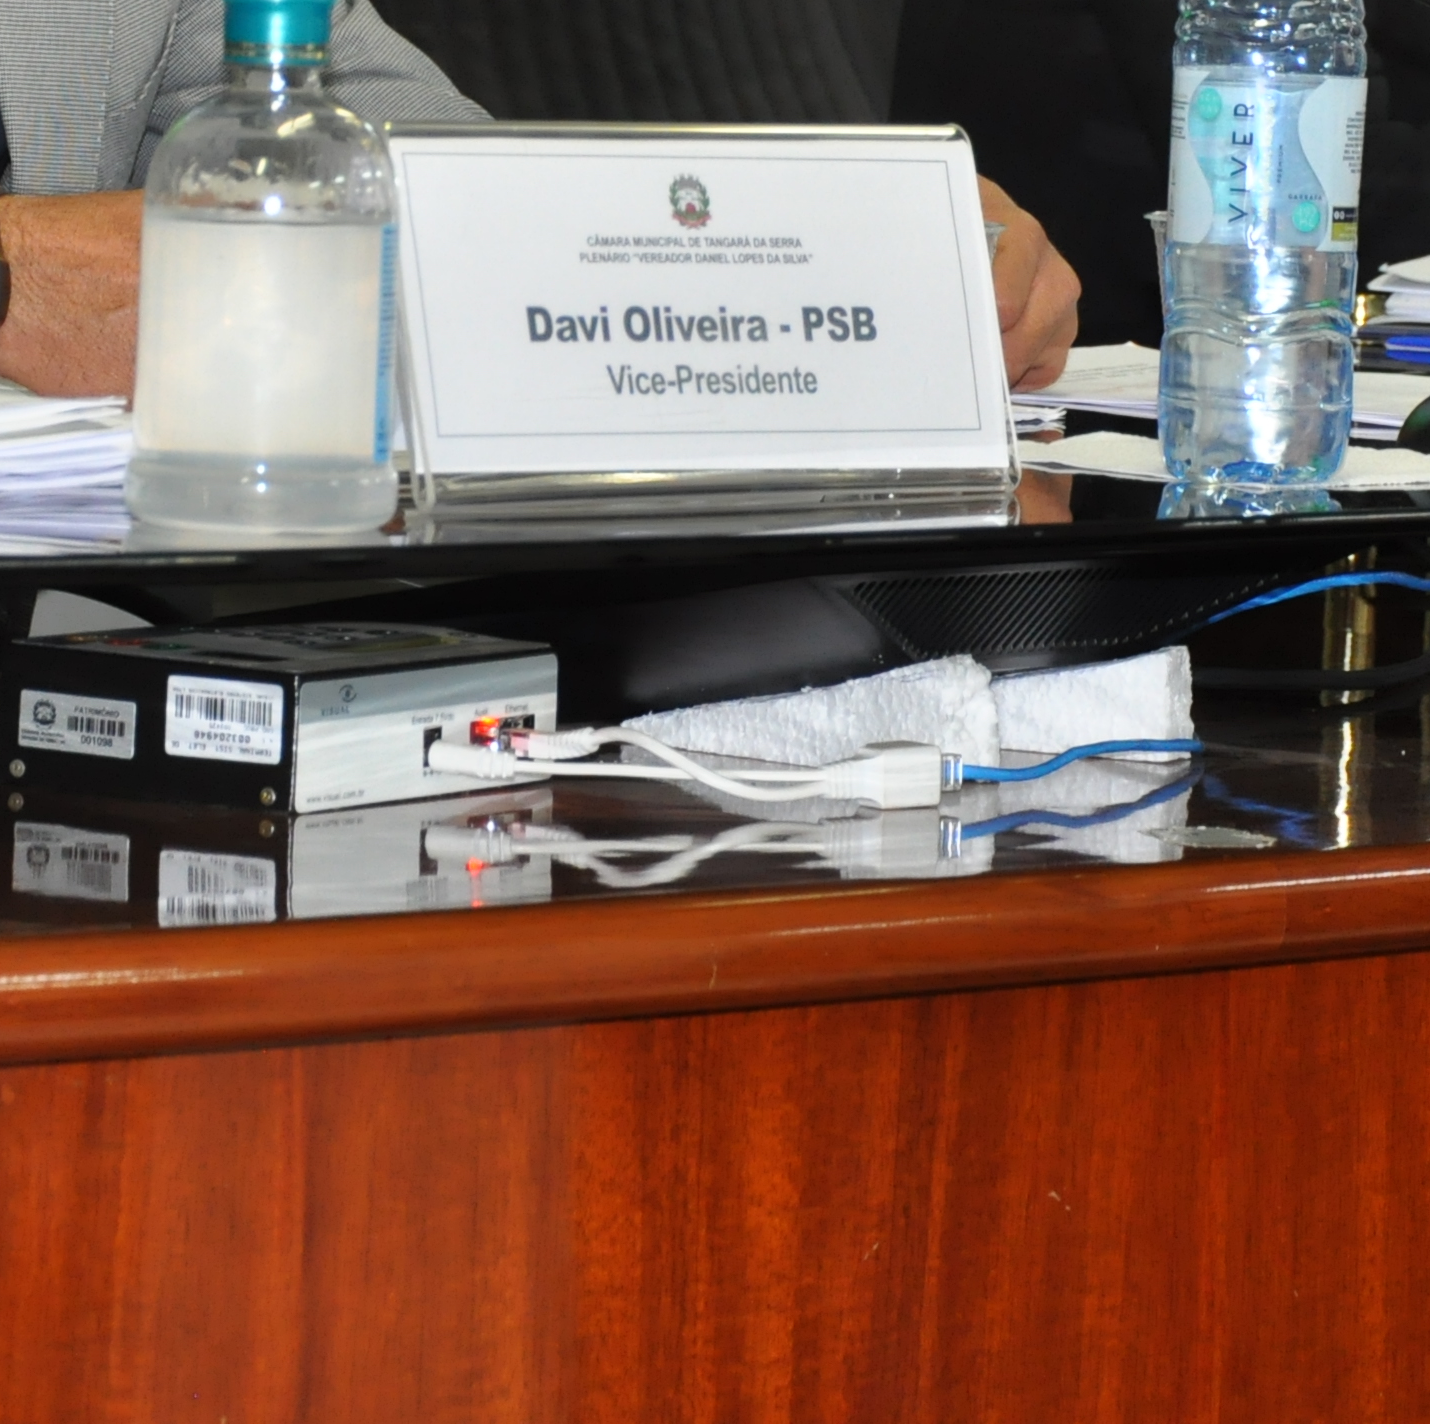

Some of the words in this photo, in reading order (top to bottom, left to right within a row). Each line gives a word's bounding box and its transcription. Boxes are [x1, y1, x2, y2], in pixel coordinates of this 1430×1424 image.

[1228, 102, 1255, 225] VIVER
[579, 251, 631, 264] PLENÁRIO
[695, 253, 731, 265] DANIEL
[733, 253, 765, 265] LOPES
[766, 253, 781, 265] DA
[587, 234, 631, 248] CÂMARA
[633, 236, 686, 248] MUNICIPAL
[688, 237, 701, 248] DE
[704, 235, 751, 249] TANGARÁ
[753, 237, 767, 248] DA
[769, 237, 803, 249] SERRA
[525, 305, 611, 343] Davi
[623, 305, 770, 343] Oliveira
[801, 305, 878, 343] PSB
[605, 363, 819, 396] Vice-Presidente
